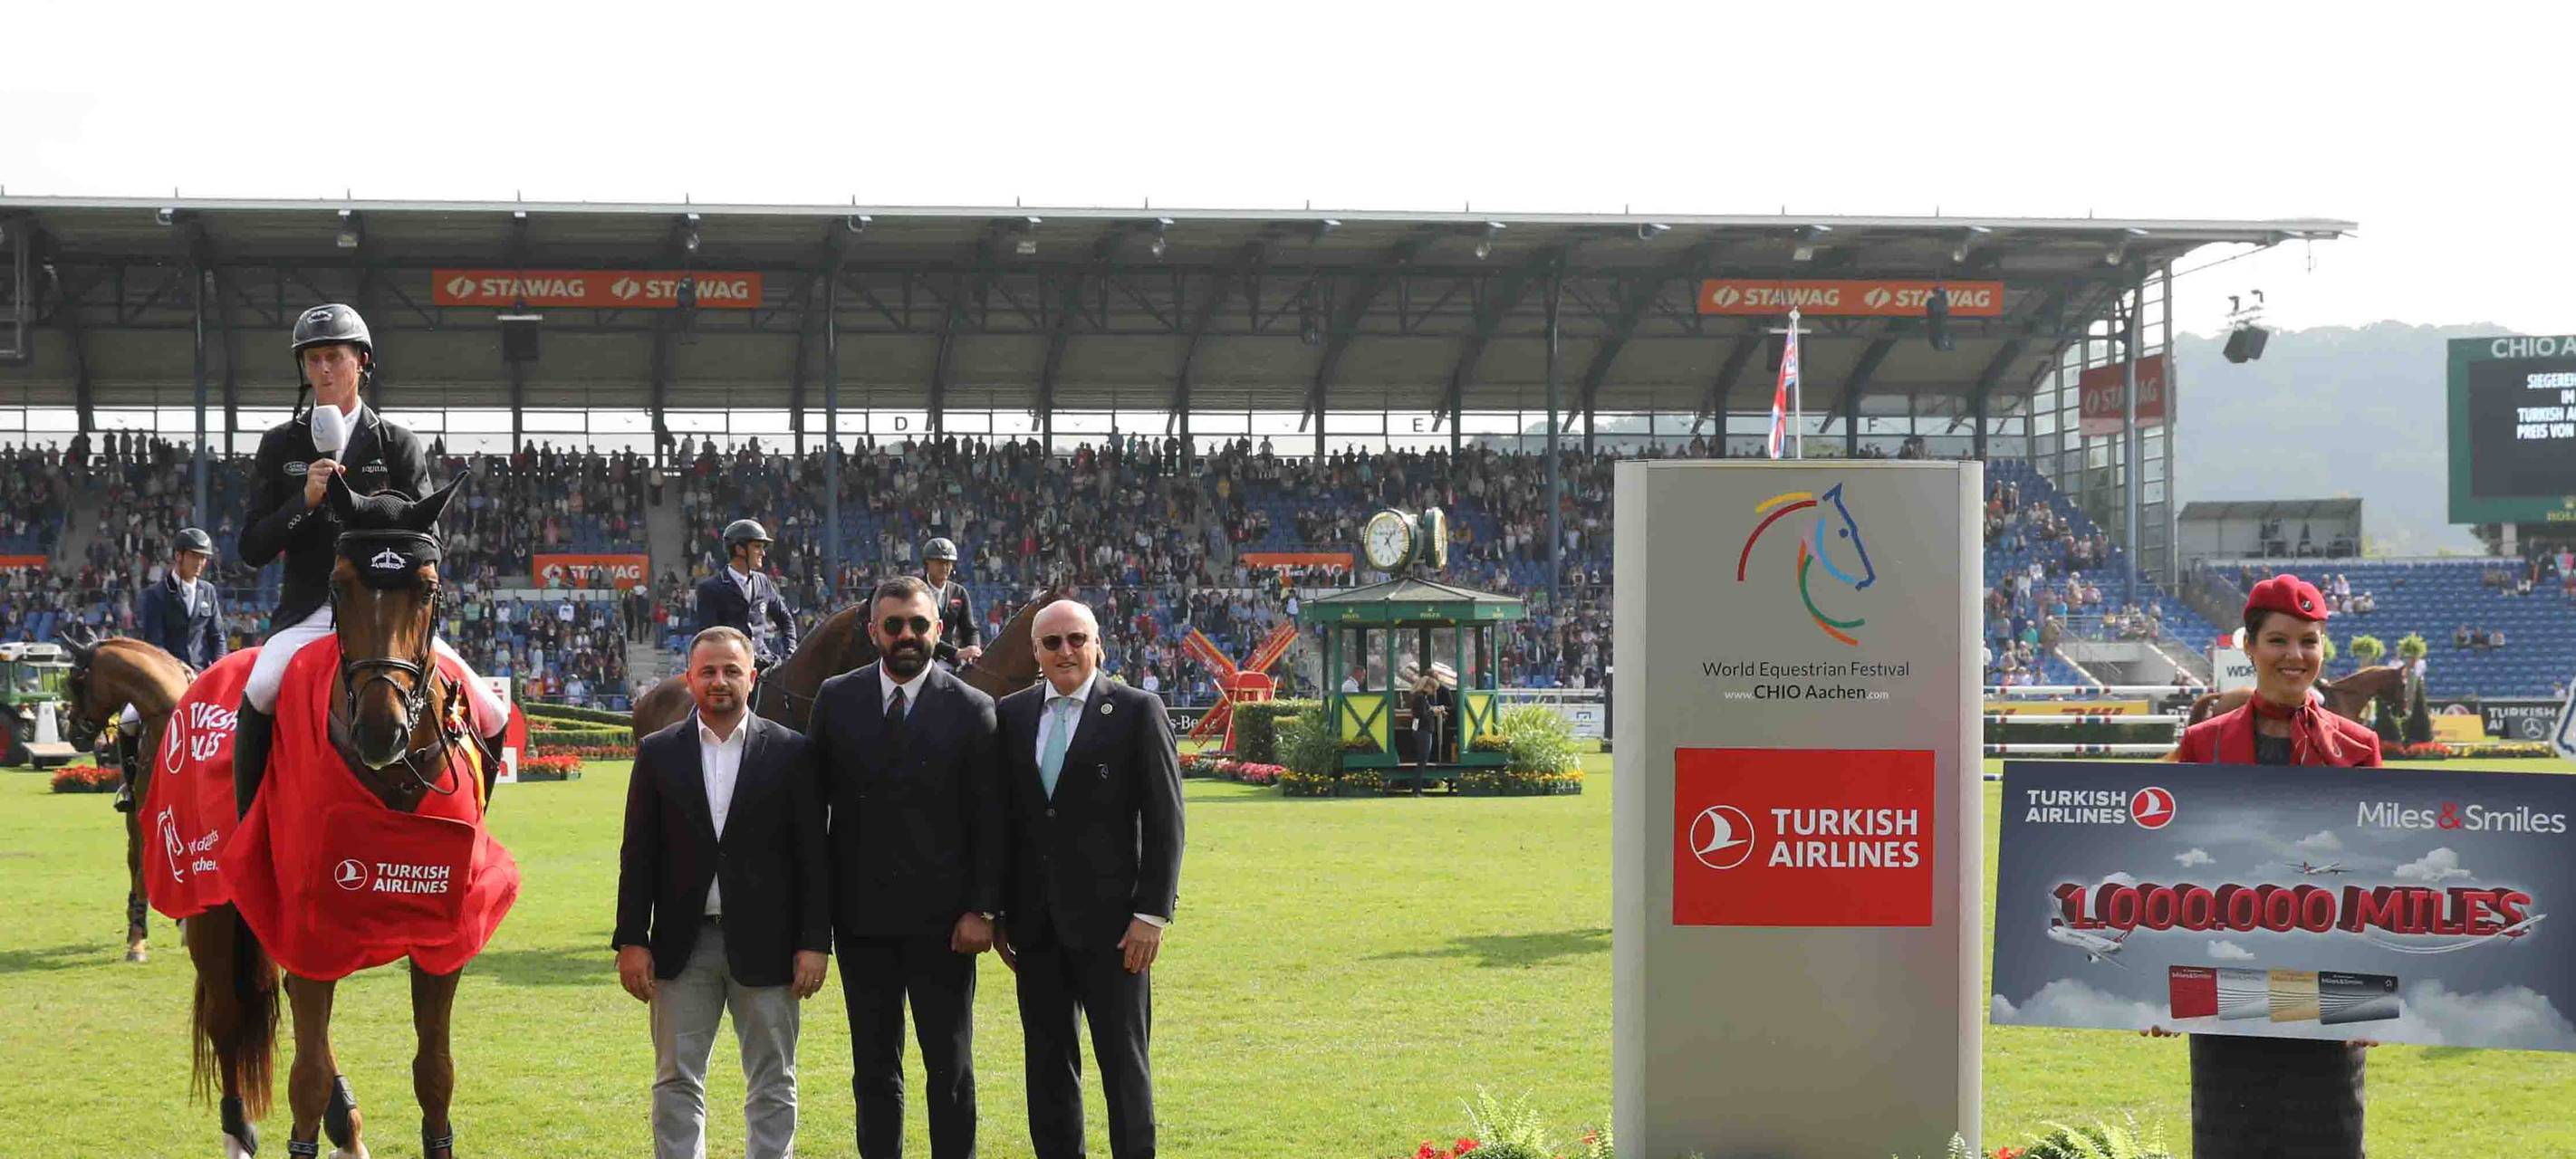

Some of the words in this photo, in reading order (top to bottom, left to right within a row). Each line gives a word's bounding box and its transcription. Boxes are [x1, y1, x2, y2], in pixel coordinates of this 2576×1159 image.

[481, 278, 585, 298] STAWAG
[1744, 288, 1841, 306] STAWAG
[2491, 338, 2557, 359] CHIO
[2561, 389, 2576, 404] IM
[2516, 407, 2564, 423] TURKISH
[895, 417, 908, 431] D
[1413, 417, 1425, 433] E
[1868, 417, 1879, 433] F
[2516, 424, 2548, 439] PREIS
[1703, 661, 1754, 676] World
[1760, 661, 1847, 679] Equestrian
[1851, 661, 1910, 676] Festival
[2488, 706, 2557, 719] TURKISH
[2027, 790, 2127, 807] TURKISH
[1771, 809, 1918, 836] TURKISH
[2024, 807, 2127, 824] AIRLINES
[2357, 800, 2567, 834] Miles&Smiles
[1767, 840, 1920, 868] AIRLINES
[376, 863, 451, 879] TURKISH
[372, 878, 449, 894] AIRLINES
[2339, 884, 2533, 938] MILES
